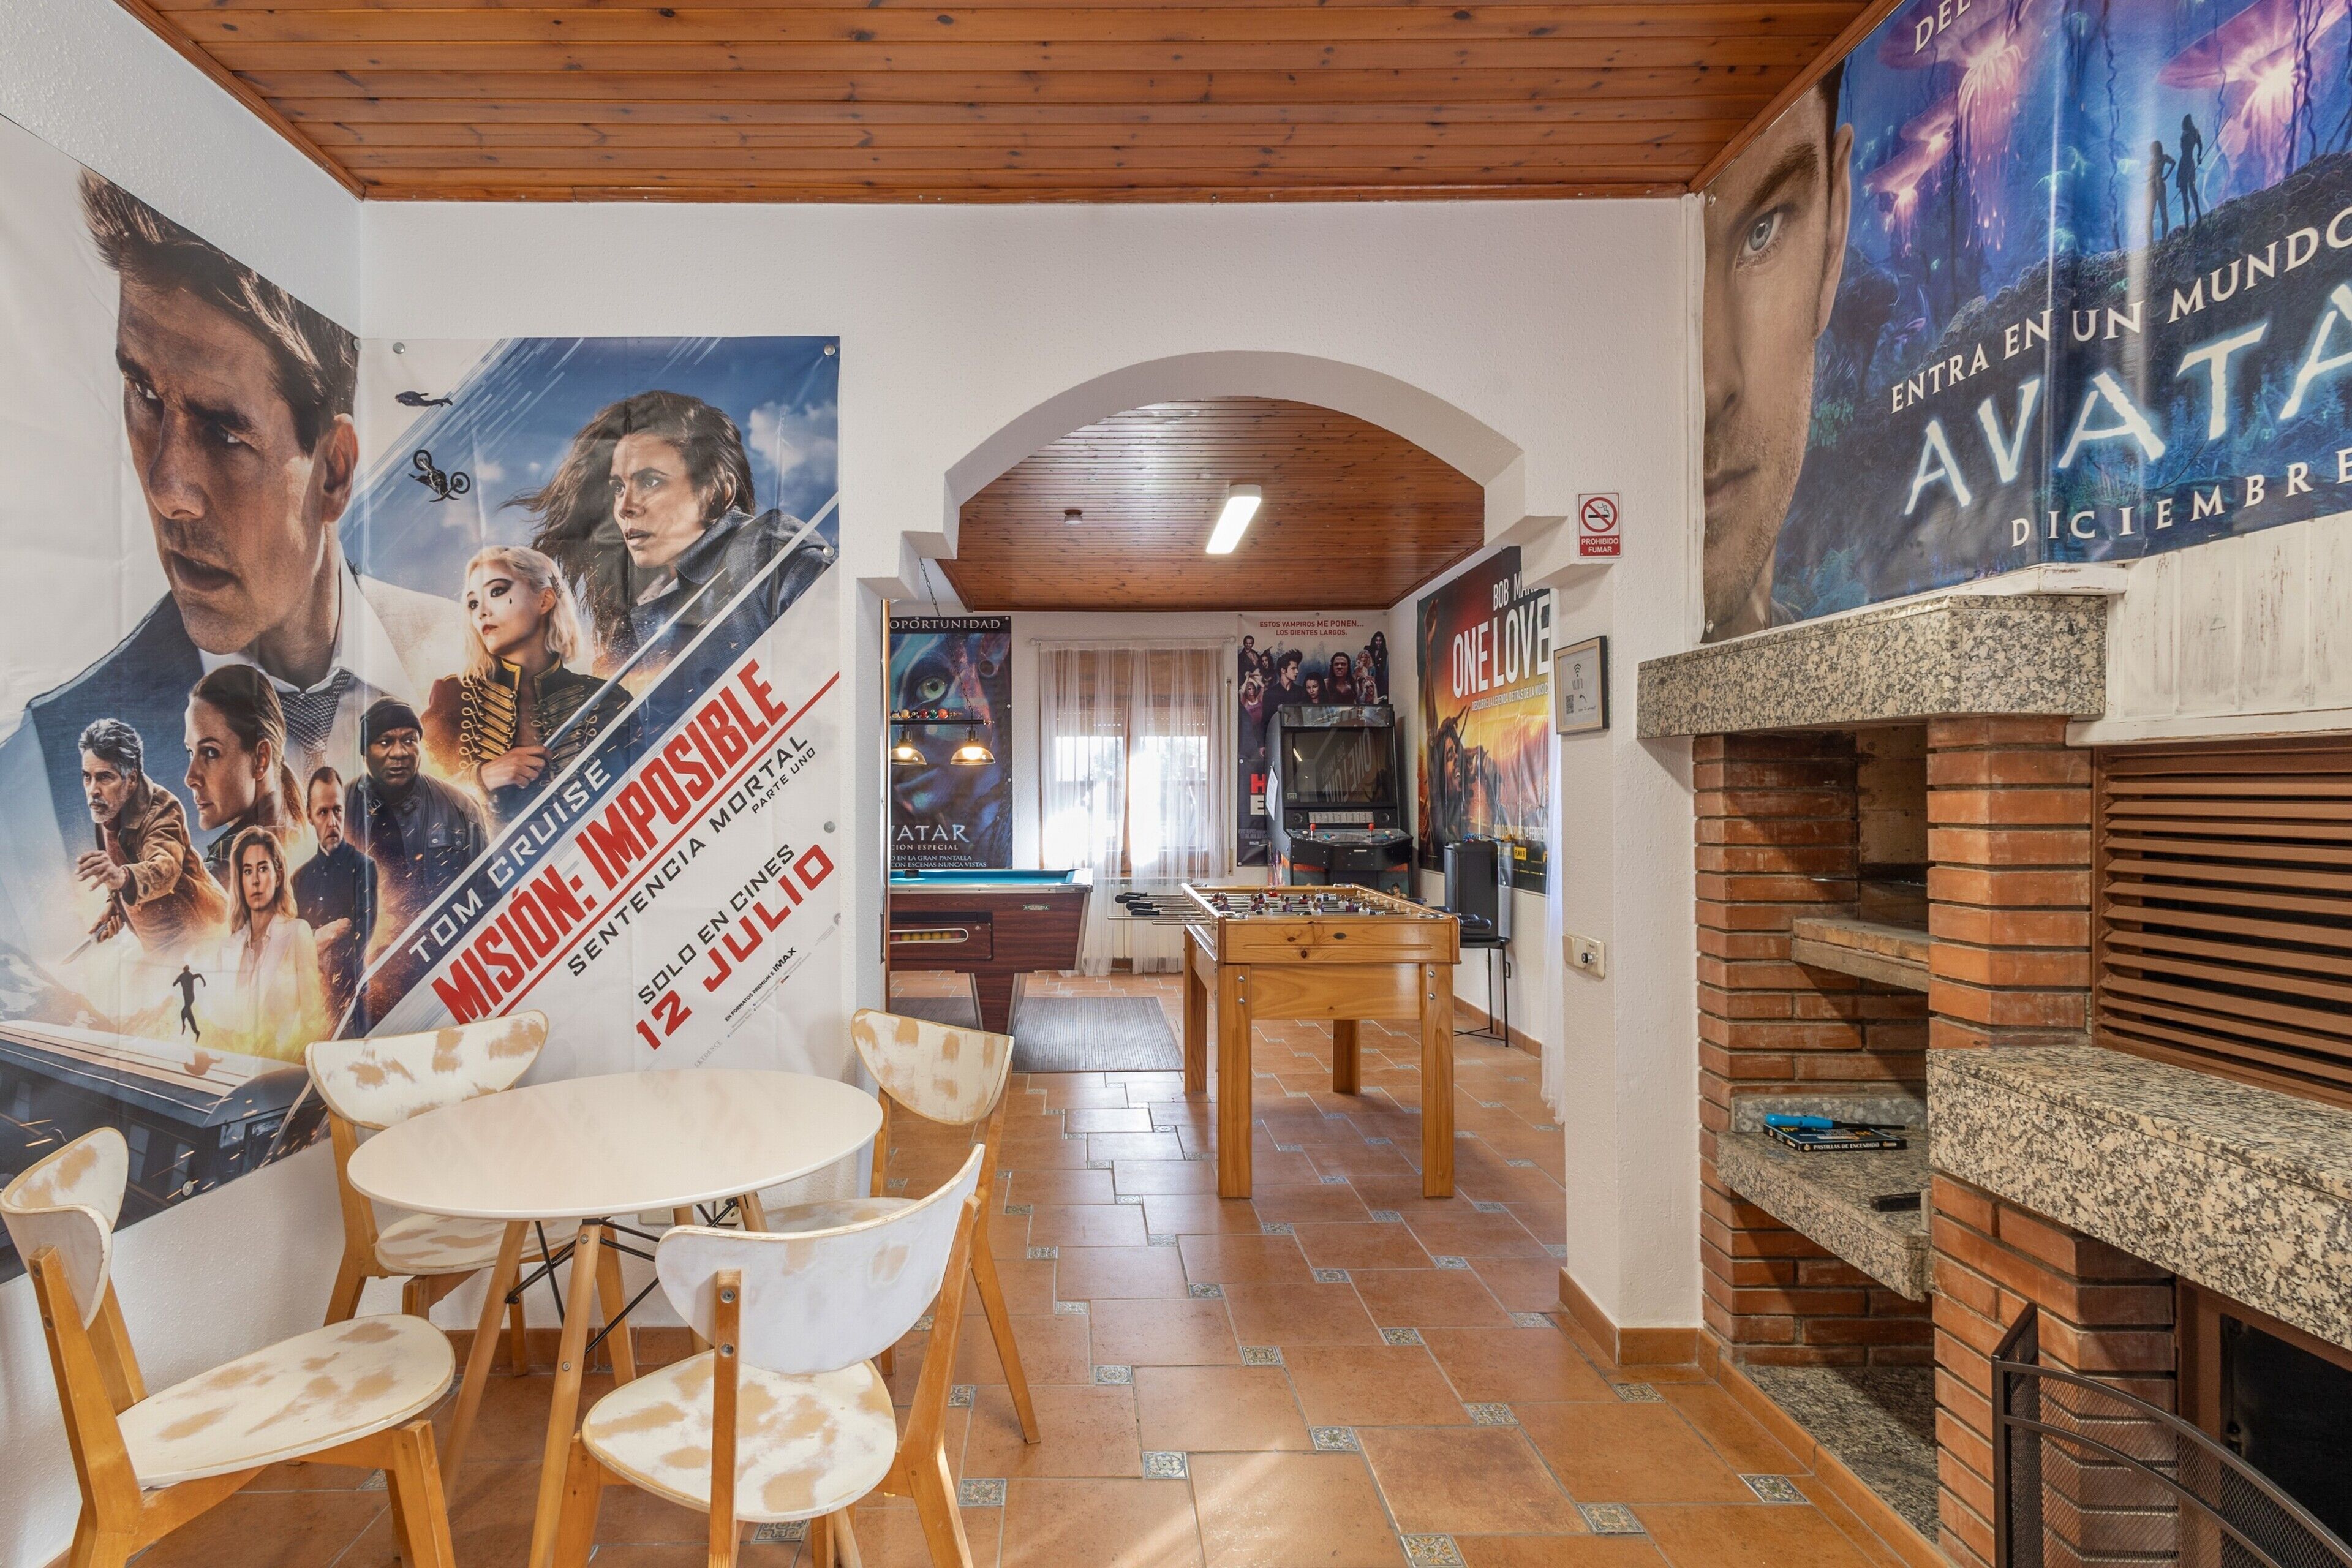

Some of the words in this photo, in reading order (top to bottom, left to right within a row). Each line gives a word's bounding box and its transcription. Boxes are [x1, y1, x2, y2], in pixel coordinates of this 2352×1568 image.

[1891, 342, 1990, 415] ENTRA
[2003, 308, 2052, 361] EN
[2072, 301, 2144, 342] UN
[2011, 447, 2352, 547] DICIEMBRE
[889, 619, 1000, 629] OPORTUNIDAD
[1453, 621, 1488, 698] ONE
[1493, 594, 1550, 687] LOVE
[1493, 578, 1509, 611] BOB
[751, 775, 791, 815] PARTE
[790, 747, 816, 775] UNO
[408, 888, 484, 963] TOM
[487, 760, 611, 887] CRUISE
[431, 864, 598, 1025] MISIÓN:
[575, 658, 788, 880] IMPOSIBLE
[567, 837, 706, 977] SENTENCIA
[709, 736, 809, 834] MORTAL
[891, 824, 970, 843] ATAR
[636, 989, 693, 1050] 12
[702, 843, 834, 993] JULIO
[638, 946, 696, 1005] SOLO
[698, 911, 729, 944] EN
[729, 843, 794, 911] CINES
[731, 993, 753, 1016] FORMATOS
[752, 974, 772, 995] PREMIUM
[772, 946, 797, 972] IMAX
